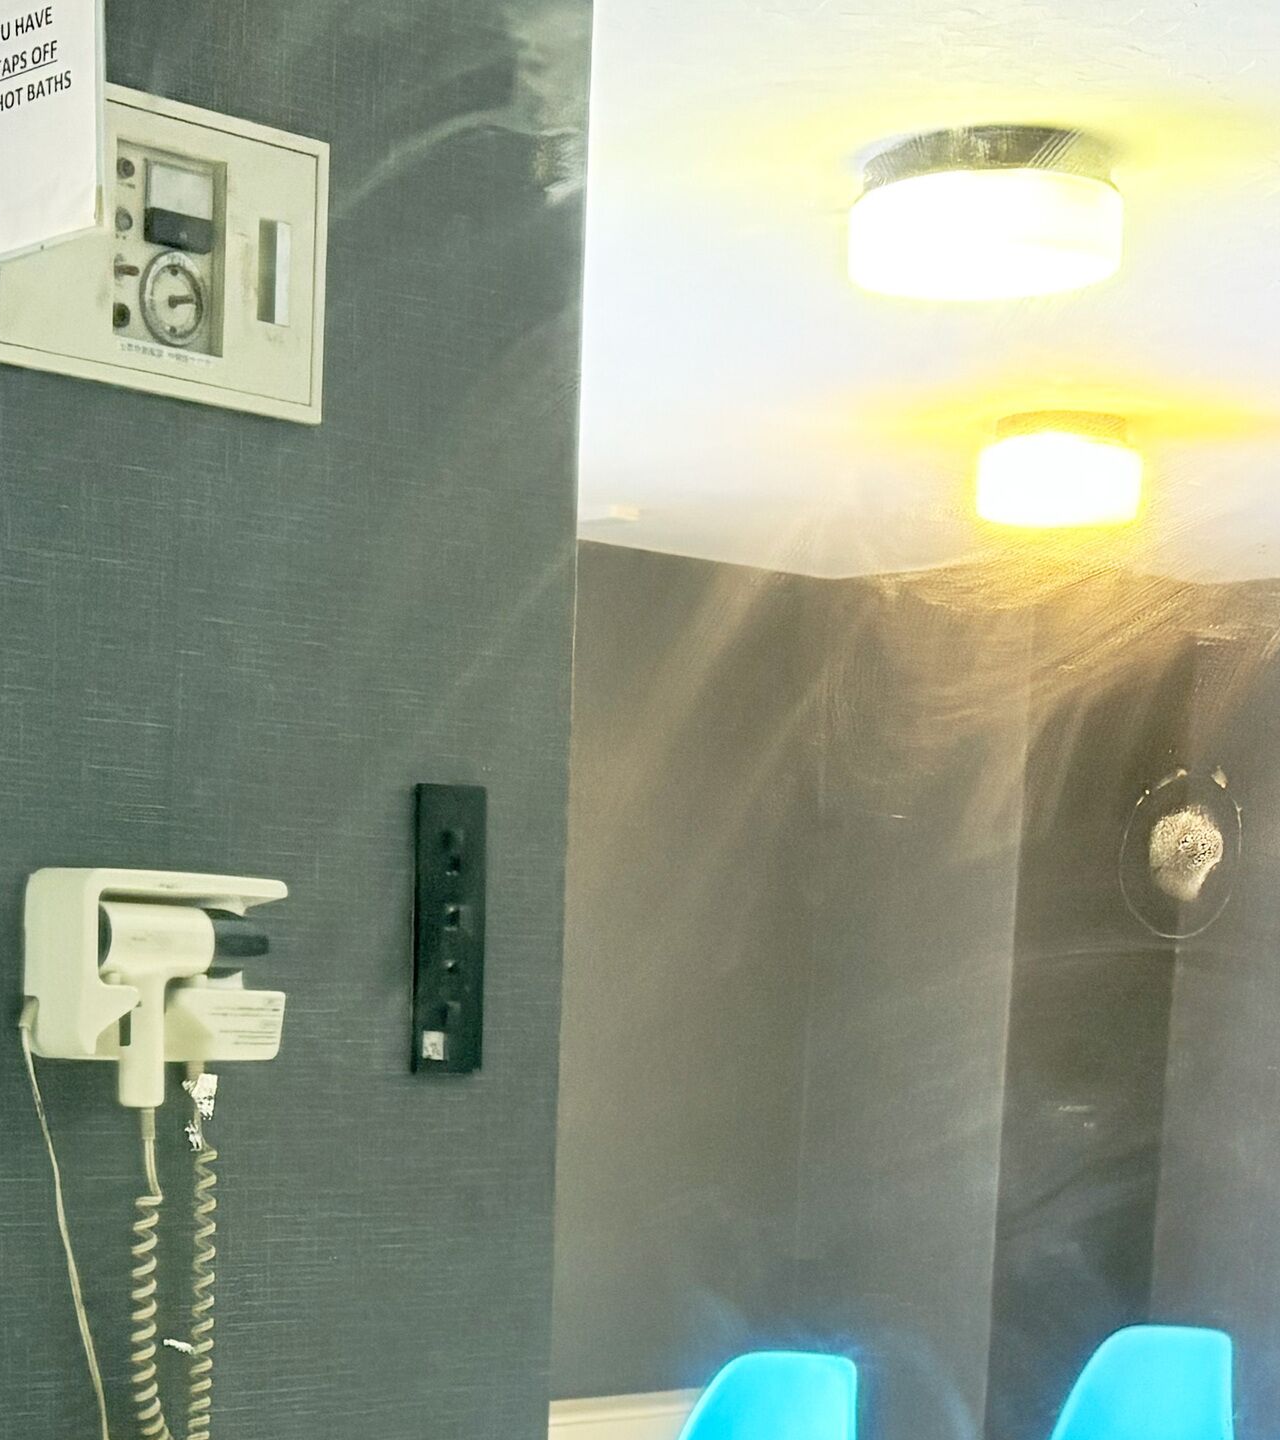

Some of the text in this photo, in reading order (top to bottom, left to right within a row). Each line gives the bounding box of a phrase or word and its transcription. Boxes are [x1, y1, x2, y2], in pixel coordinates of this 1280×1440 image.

[14, 6, 53, 37] HAVE
[31, 40, 58, 65] OFF
[27, 70, 72, 102] BATHS
